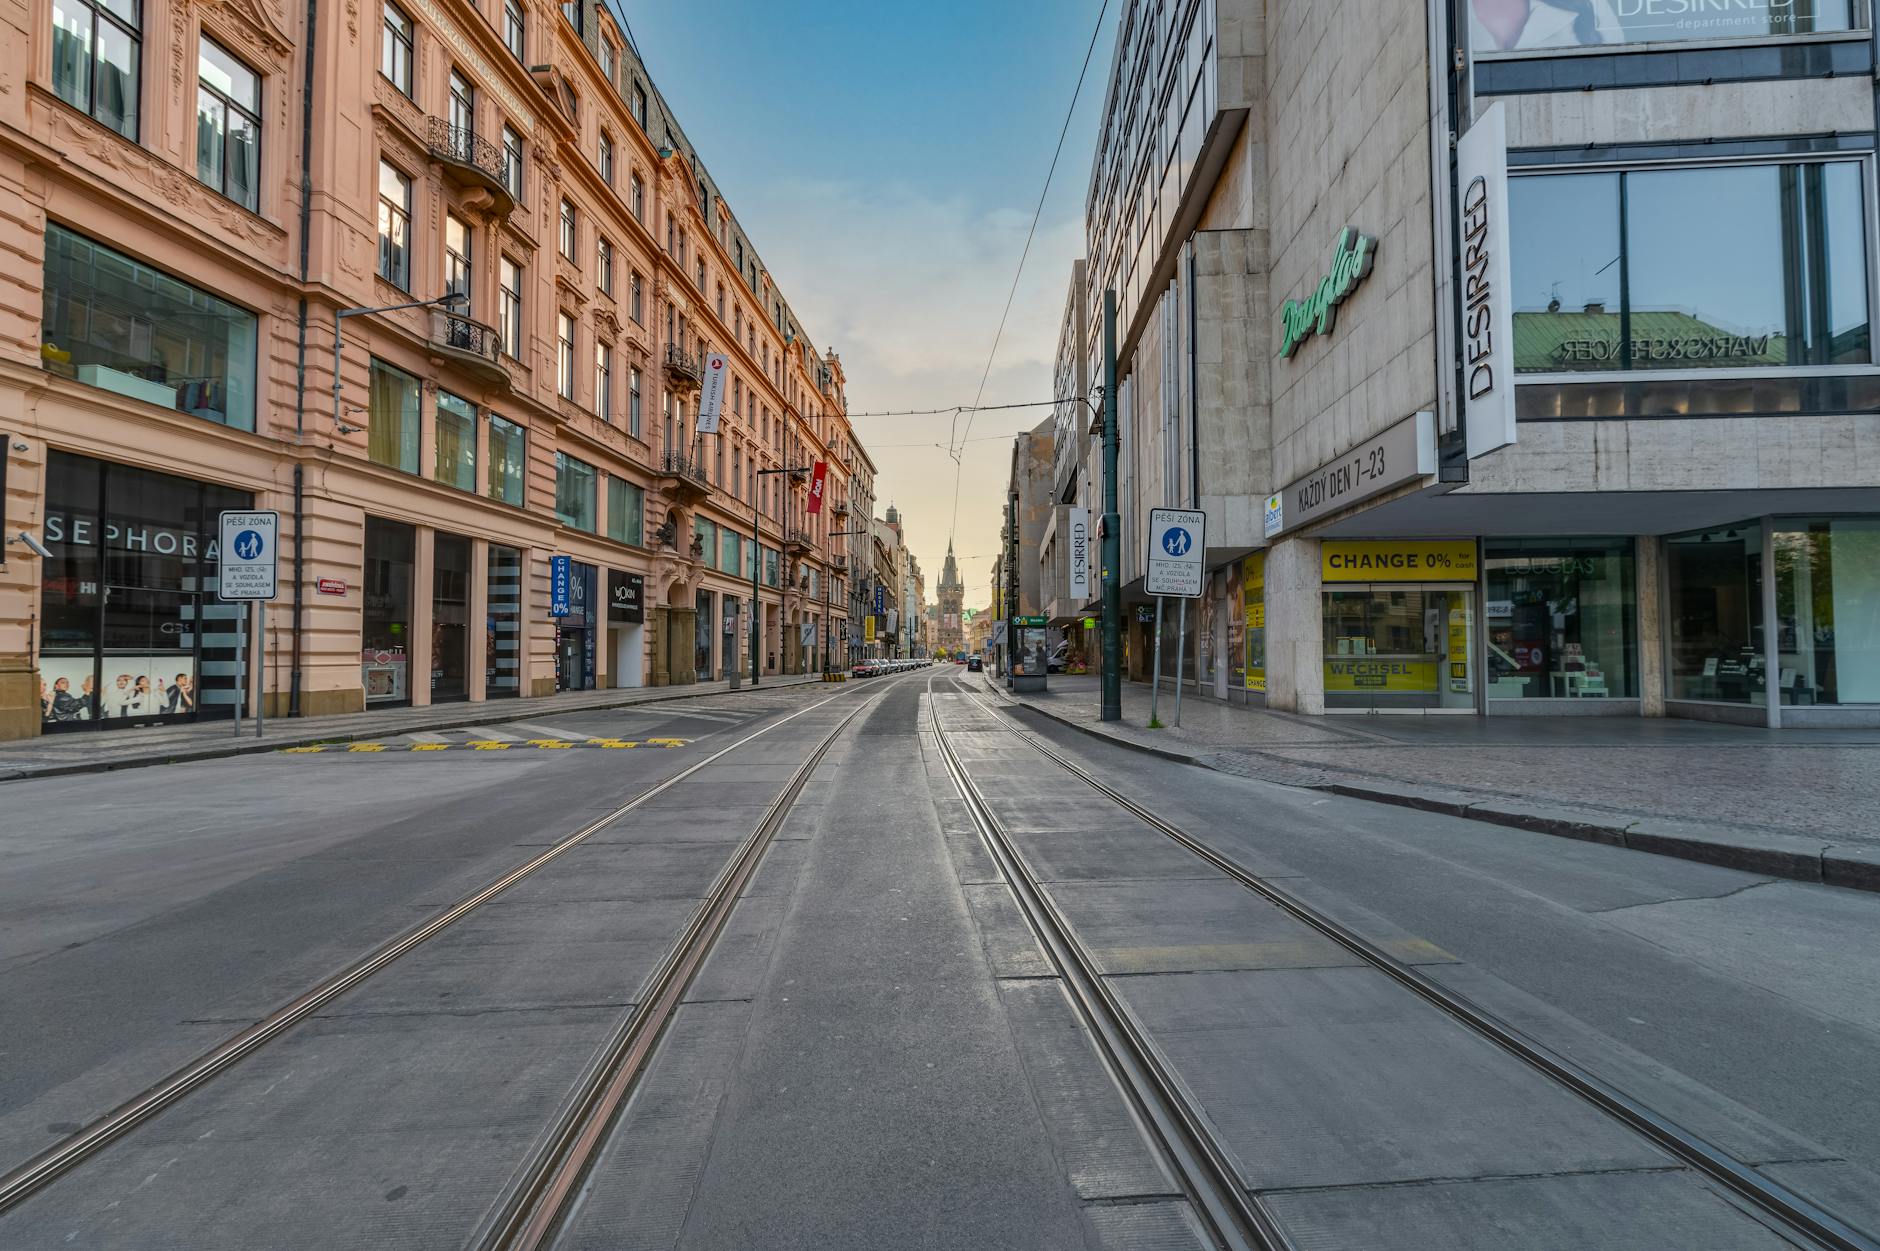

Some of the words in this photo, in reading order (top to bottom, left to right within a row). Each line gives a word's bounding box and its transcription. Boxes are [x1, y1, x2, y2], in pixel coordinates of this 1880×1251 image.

[1676, 16, 1756, 29] department
[1760, 14, 1797, 24] store
[1464, 175, 1494, 401] DESIRRED
[709, 373, 719, 400] TURKISH
[704, 401, 714, 430] AIRLINES
[1298, 471, 1327, 513] KAŽDÝ
[1330, 463, 1351, 498] DEN
[226, 515, 246, 526] PĚŠÍ
[248, 515, 272, 526] ZÓNA
[1155, 513, 1174, 522] PĚŠÍ
[1177, 514, 1201, 524] ZÓNA
[1074, 523, 1086, 585] DESIRRED
[1329, 553, 1419, 569] CHANGE
[1425, 553, 1451, 569] 0%
[557, 558, 565, 601] CHANGE
[553, 602, 569, 614] 0%
[1330, 663, 1413, 675] WECHSEL
